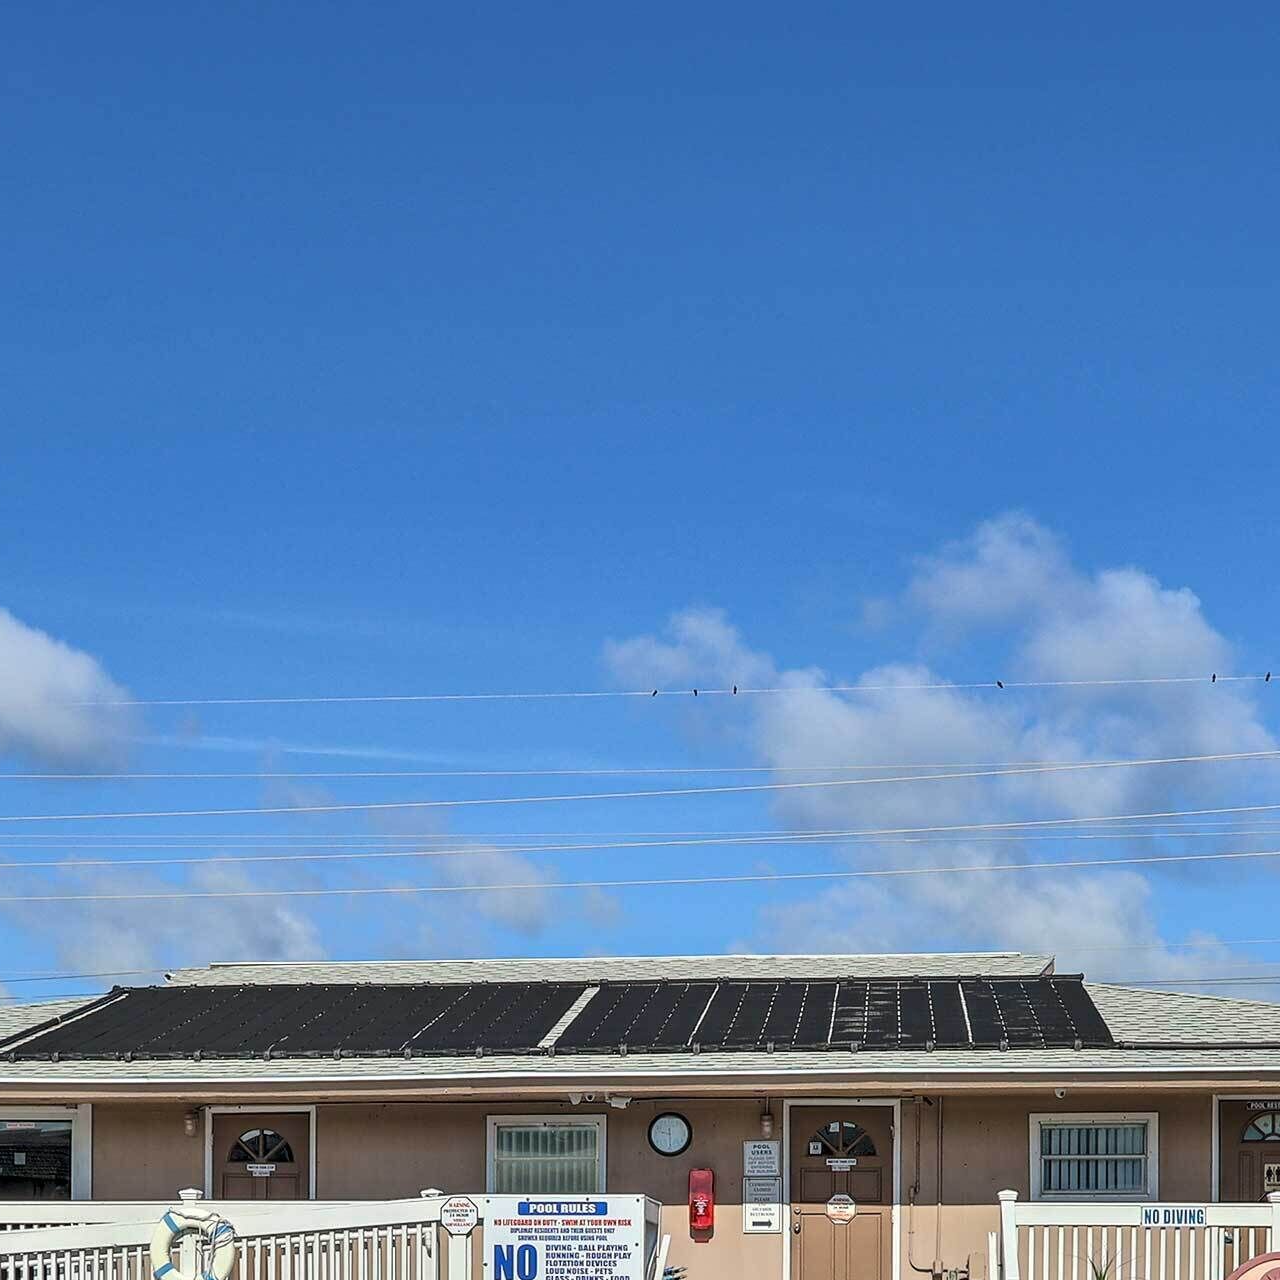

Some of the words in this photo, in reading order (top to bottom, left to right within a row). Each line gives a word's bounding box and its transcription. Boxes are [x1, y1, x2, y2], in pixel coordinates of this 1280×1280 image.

[529, 1204, 560, 1213] POOL
[560, 1204, 596, 1213] RULES
[1144, 1209, 1160, 1224] NO
[1163, 1209, 1204, 1224] DIVING
